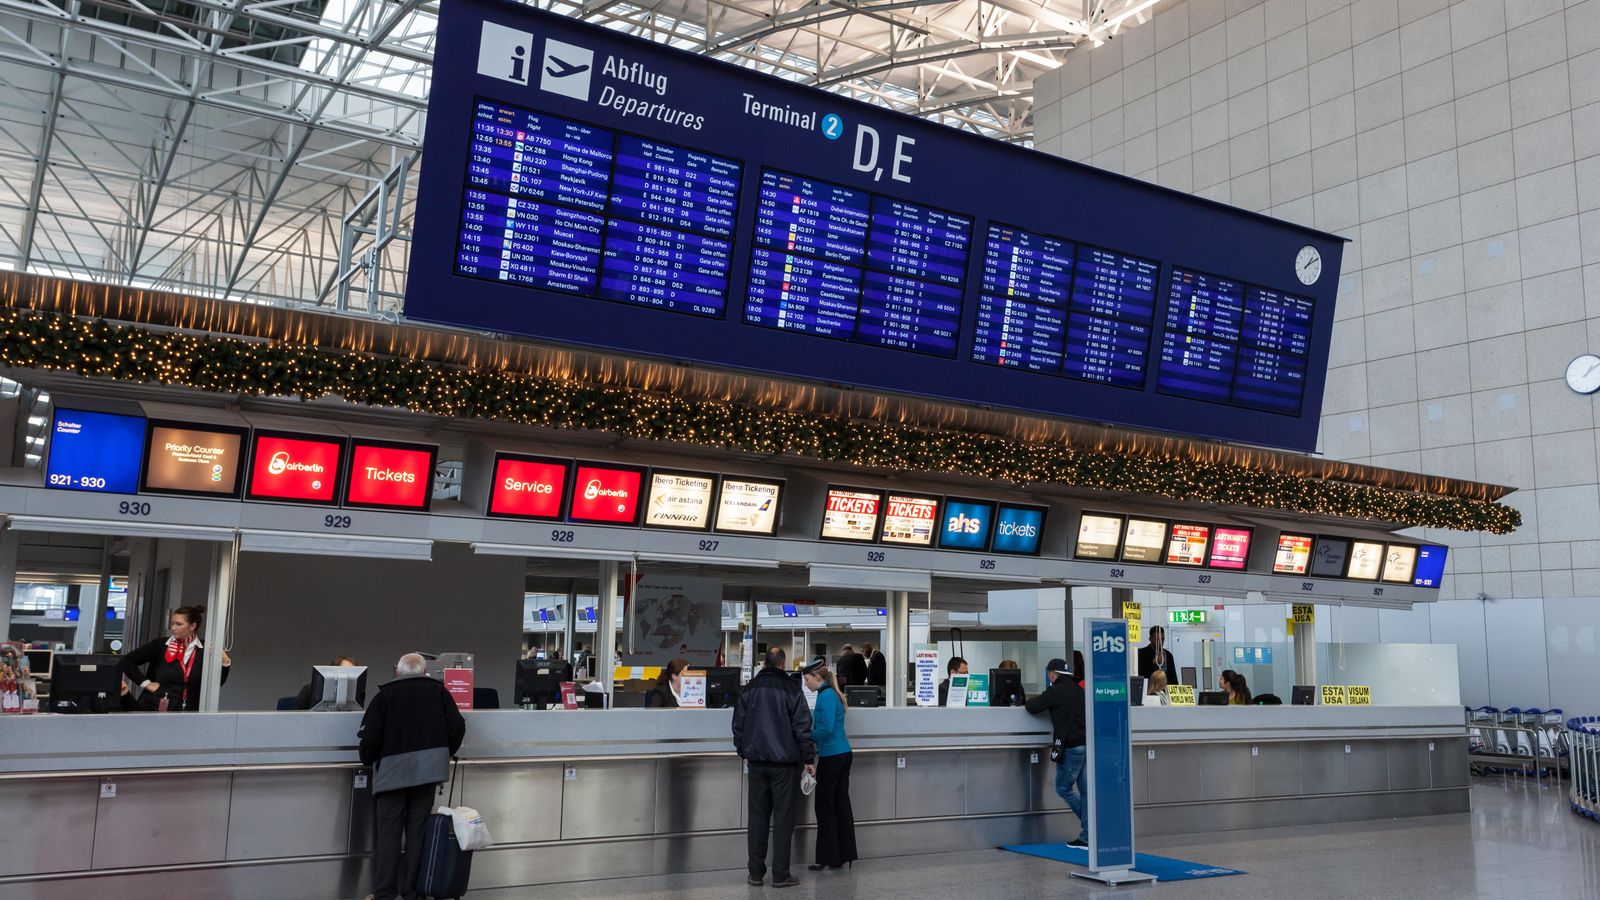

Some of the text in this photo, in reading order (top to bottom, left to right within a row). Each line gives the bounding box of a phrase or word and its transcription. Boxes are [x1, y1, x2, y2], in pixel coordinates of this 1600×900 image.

[602, 55, 668, 95] Abflug
[599, 86, 704, 130] Departures
[743, 93, 816, 130] Terminal
[827, 117, 837, 136] 2
[477, 123, 494, 132] 11:35
[496, 128, 513, 137] 13:30
[535, 137, 551, 145] 7750
[564, 144, 580, 152] Palma
[589, 149, 612, 159] Mallorca
[476, 134, 493, 143] 12:55
[495, 138, 512, 147] 13:55
[562, 154, 577, 163] Hong
[579, 157, 593, 166] Kong
[474, 144, 491, 153] 13:35
[561, 164, 608, 180] Shanghai-Pudong
[472, 165, 489, 174] 13:45
[473, 155, 490, 164] 13:40
[560, 174, 586, 185] Reykjavik
[722, 179, 734, 188] offen
[469, 191, 486, 200] 13:55
[471, 176, 488, 185] 13:45
[574, 198, 604, 210] Petersburg
[762, 189, 776, 197] 14:30
[467, 202, 485, 210] 13:55
[526, 213, 538, 221] 030
[574, 223, 588, 231] Minh
[588, 226, 599, 234] City
[466, 212, 483, 220] 13:55
[553, 229, 574, 238] Muscat
[464, 233, 481, 241] 14:15
[465, 223, 482, 231] 14:00
[524, 234, 538, 242] 2301
[462, 244, 480, 252] 14:15
[550, 260, 595, 273] Moskau-Vnukovo
[461, 254, 478, 262] 14:15
[548, 270, 566, 278] Sharm
[460, 265, 477, 273] 14:25
[547, 280, 578, 290] Amsterdam
[58, 421, 82, 429] Schalter
[165, 443, 224, 455] Priority Counter
[286, 463, 323, 473] airberlin
[50, 474, 71, 485] 921
[81, 477, 106, 488] 930
[365, 467, 416, 483] Tickets
[505, 478, 552, 494] Service
[655, 476, 708, 489] Ibero Ticketing
[598, 489, 627, 498] airberlin
[744, 485, 776, 495] Ticketing
[667, 495, 703, 505] air astana
[724, 499, 757, 507] ICELANDAIR
[830, 497, 875, 513] TICKETS
[119, 501, 151, 516] 930
[889, 503, 932, 518] TICKETS
[324, 515, 351, 529] 929
[654, 513, 698, 522] FINNAIR
[947, 513, 980, 534] ahs
[1000, 520, 1036, 537] tickets
[551, 530, 574, 542] 928
[699, 539, 719, 552] 927
[1217, 544, 1240, 552] TICKETS
[867, 552, 885, 561] 926
[979, 560, 995, 570] 925
[1110, 569, 1124, 577] 924
[1198, 575, 1211, 584] 923
[1302, 583, 1314, 591] 922
[1293, 606, 1312, 615] ESTA
[1093, 630, 1125, 653] ahs
[1104, 688, 1119, 696] Lingus
[1169, 685, 1193, 695] LAST MINUTE
[1322, 687, 1344, 695] ESTA
[1348, 687, 1369, 696] VISUM
[1325, 696, 1342, 704] USA
